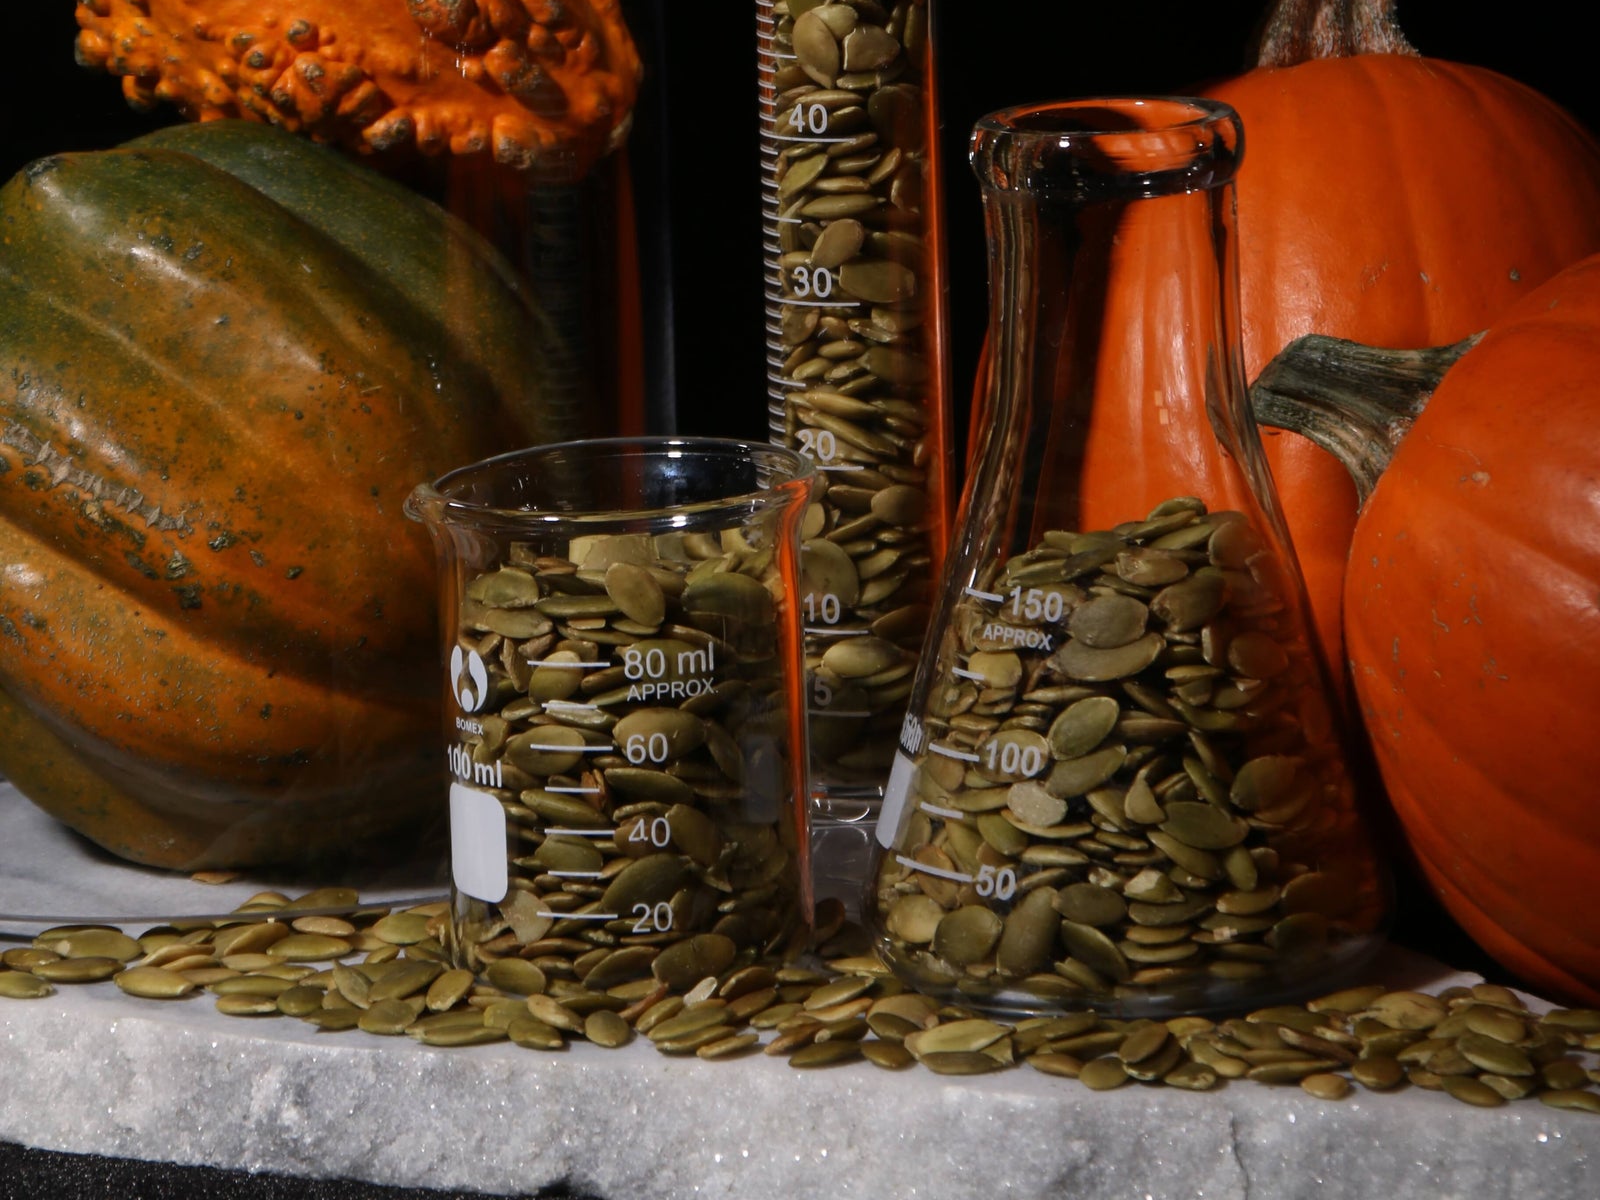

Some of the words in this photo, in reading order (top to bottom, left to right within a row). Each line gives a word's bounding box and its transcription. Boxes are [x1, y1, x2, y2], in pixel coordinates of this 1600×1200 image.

[789, 103, 828, 134] 40
[793, 266, 832, 298] 30
[798, 429, 836, 461] 20
[804, 592, 840, 624] 10
[1010, 585, 1063, 623] 150
[982, 623, 1053, 651] APPROX
[624, 648, 666, 679] 80
[677, 641, 714, 675] ml
[626, 676, 719, 702] APPROX.
[814, 675, 832, 706] 5
[456, 716, 484, 735] BOMEX
[626, 732, 669, 765] 60
[986, 739, 1041, 777] 100
[448, 743, 471, 780] 100
[474, 759, 502, 788] ml
[628, 817, 671, 847] 40
[975, 864, 1016, 900] 50
[632, 901, 673, 933] 20
